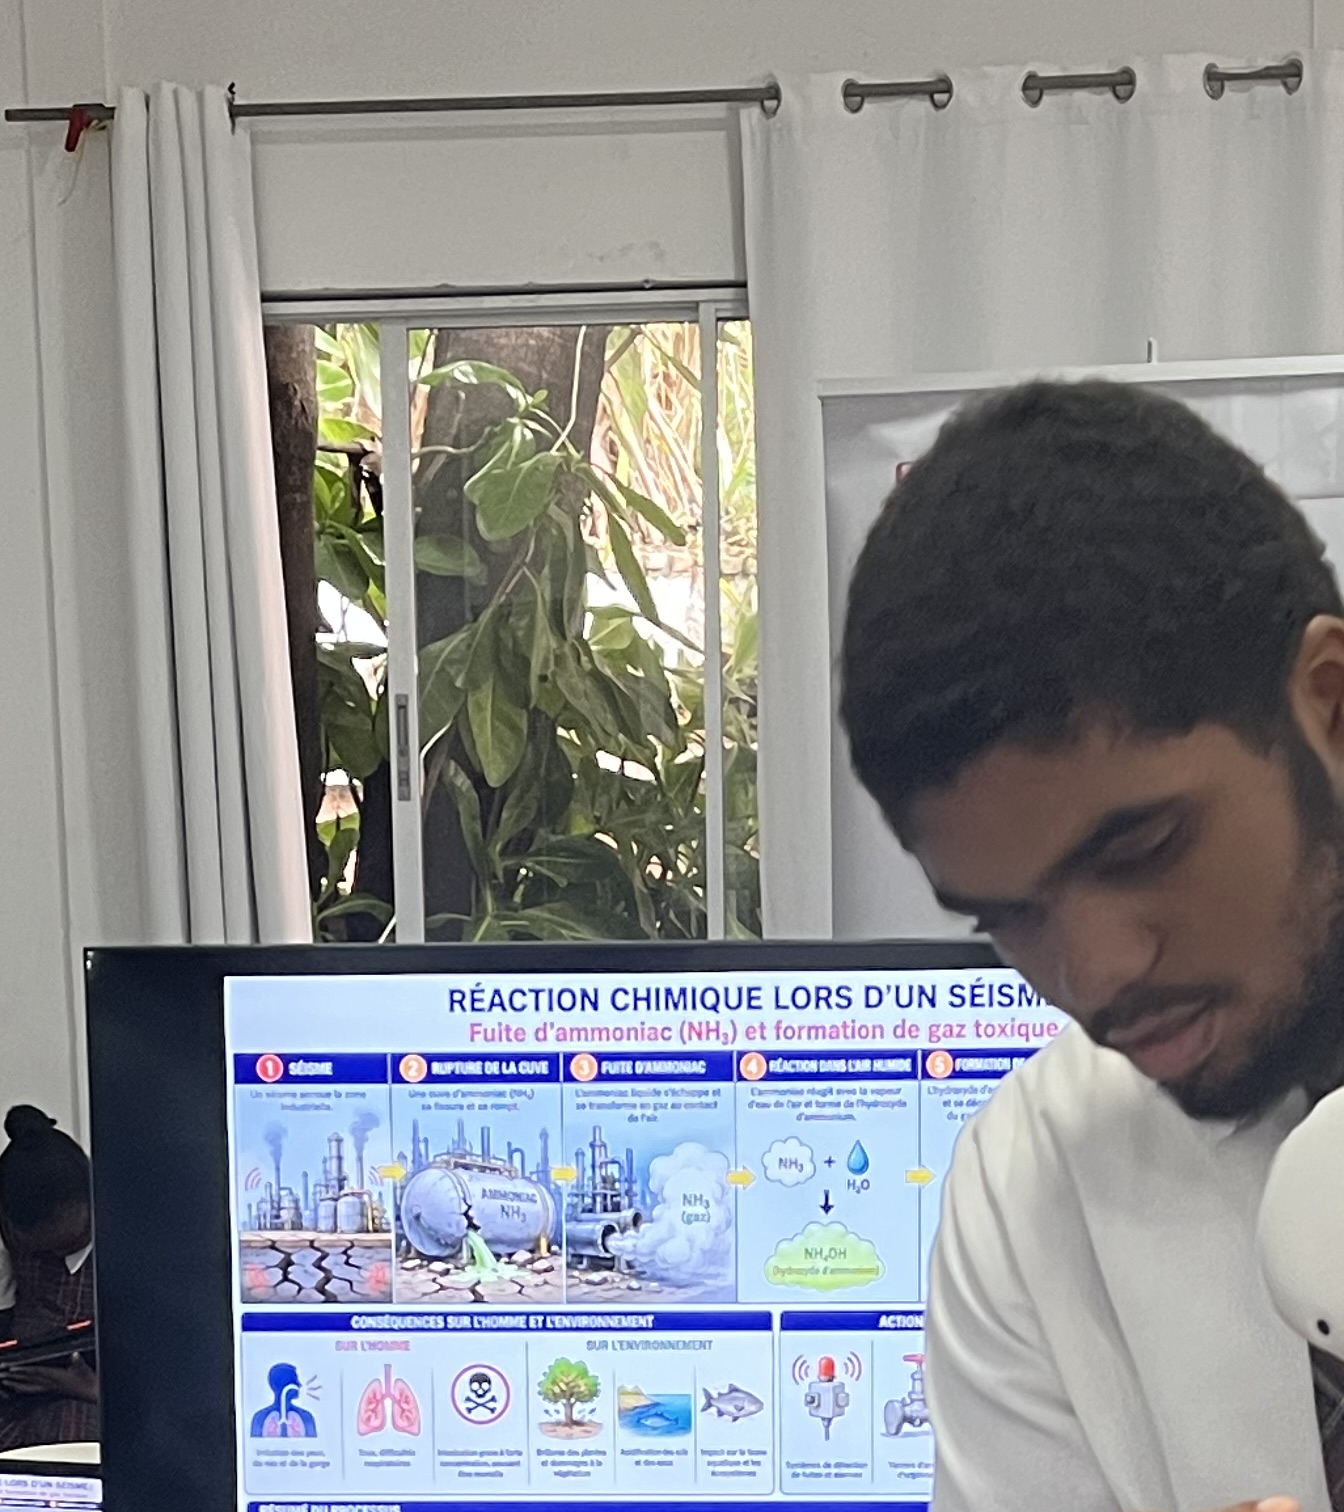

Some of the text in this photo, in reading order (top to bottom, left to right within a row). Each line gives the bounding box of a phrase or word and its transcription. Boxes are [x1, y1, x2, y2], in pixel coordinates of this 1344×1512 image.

[449, 977, 1048, 1013] RÉACTION CHIMIQUE LORS D'UN SÉISM
[470, 1022, 526, 1042] Fuite
[534, 1021, 672, 1042] d'ammoniac
[745, 1022, 766, 1040] et
[774, 1019, 884, 1040] formation
[893, 1018, 920, 1039] de
[929, 1024, 966, 1043] gaz
[484, 1061, 499, 1074] DE
[502, 1061, 517, 1074] LA
[518, 1061, 548, 1074] CUVE
[601, 1061, 633, 1074] FUITE
[351, 1314, 655, 1330] CONSÉQUENCES SUR L'HOMME ET L'ENVIRONNEMENT
[586, 1340, 608, 1351] SUR
